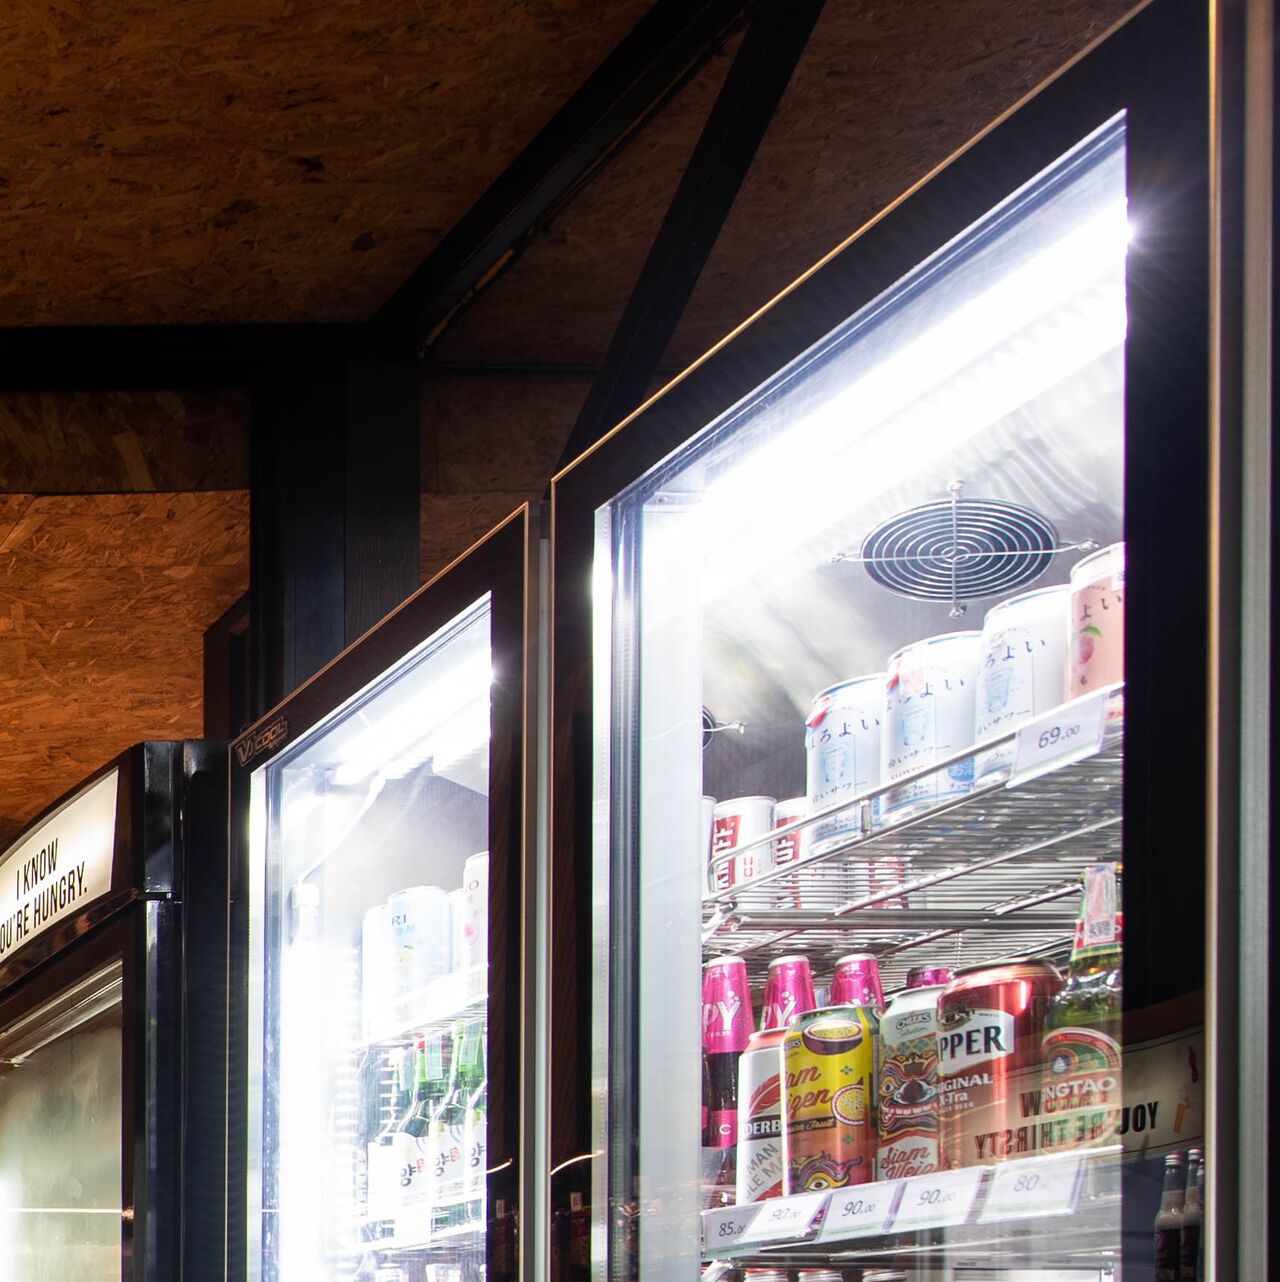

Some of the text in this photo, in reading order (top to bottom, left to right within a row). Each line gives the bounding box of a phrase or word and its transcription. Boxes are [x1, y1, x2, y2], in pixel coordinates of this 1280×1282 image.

[1038, 725, 1081, 750] 69.00
[16, 837, 58, 901] I KNOW
[33, 860, 88, 931] HUNGRY.
[880, 1146, 930, 1169] Siam
[841, 1200, 876, 1217] 90.00
